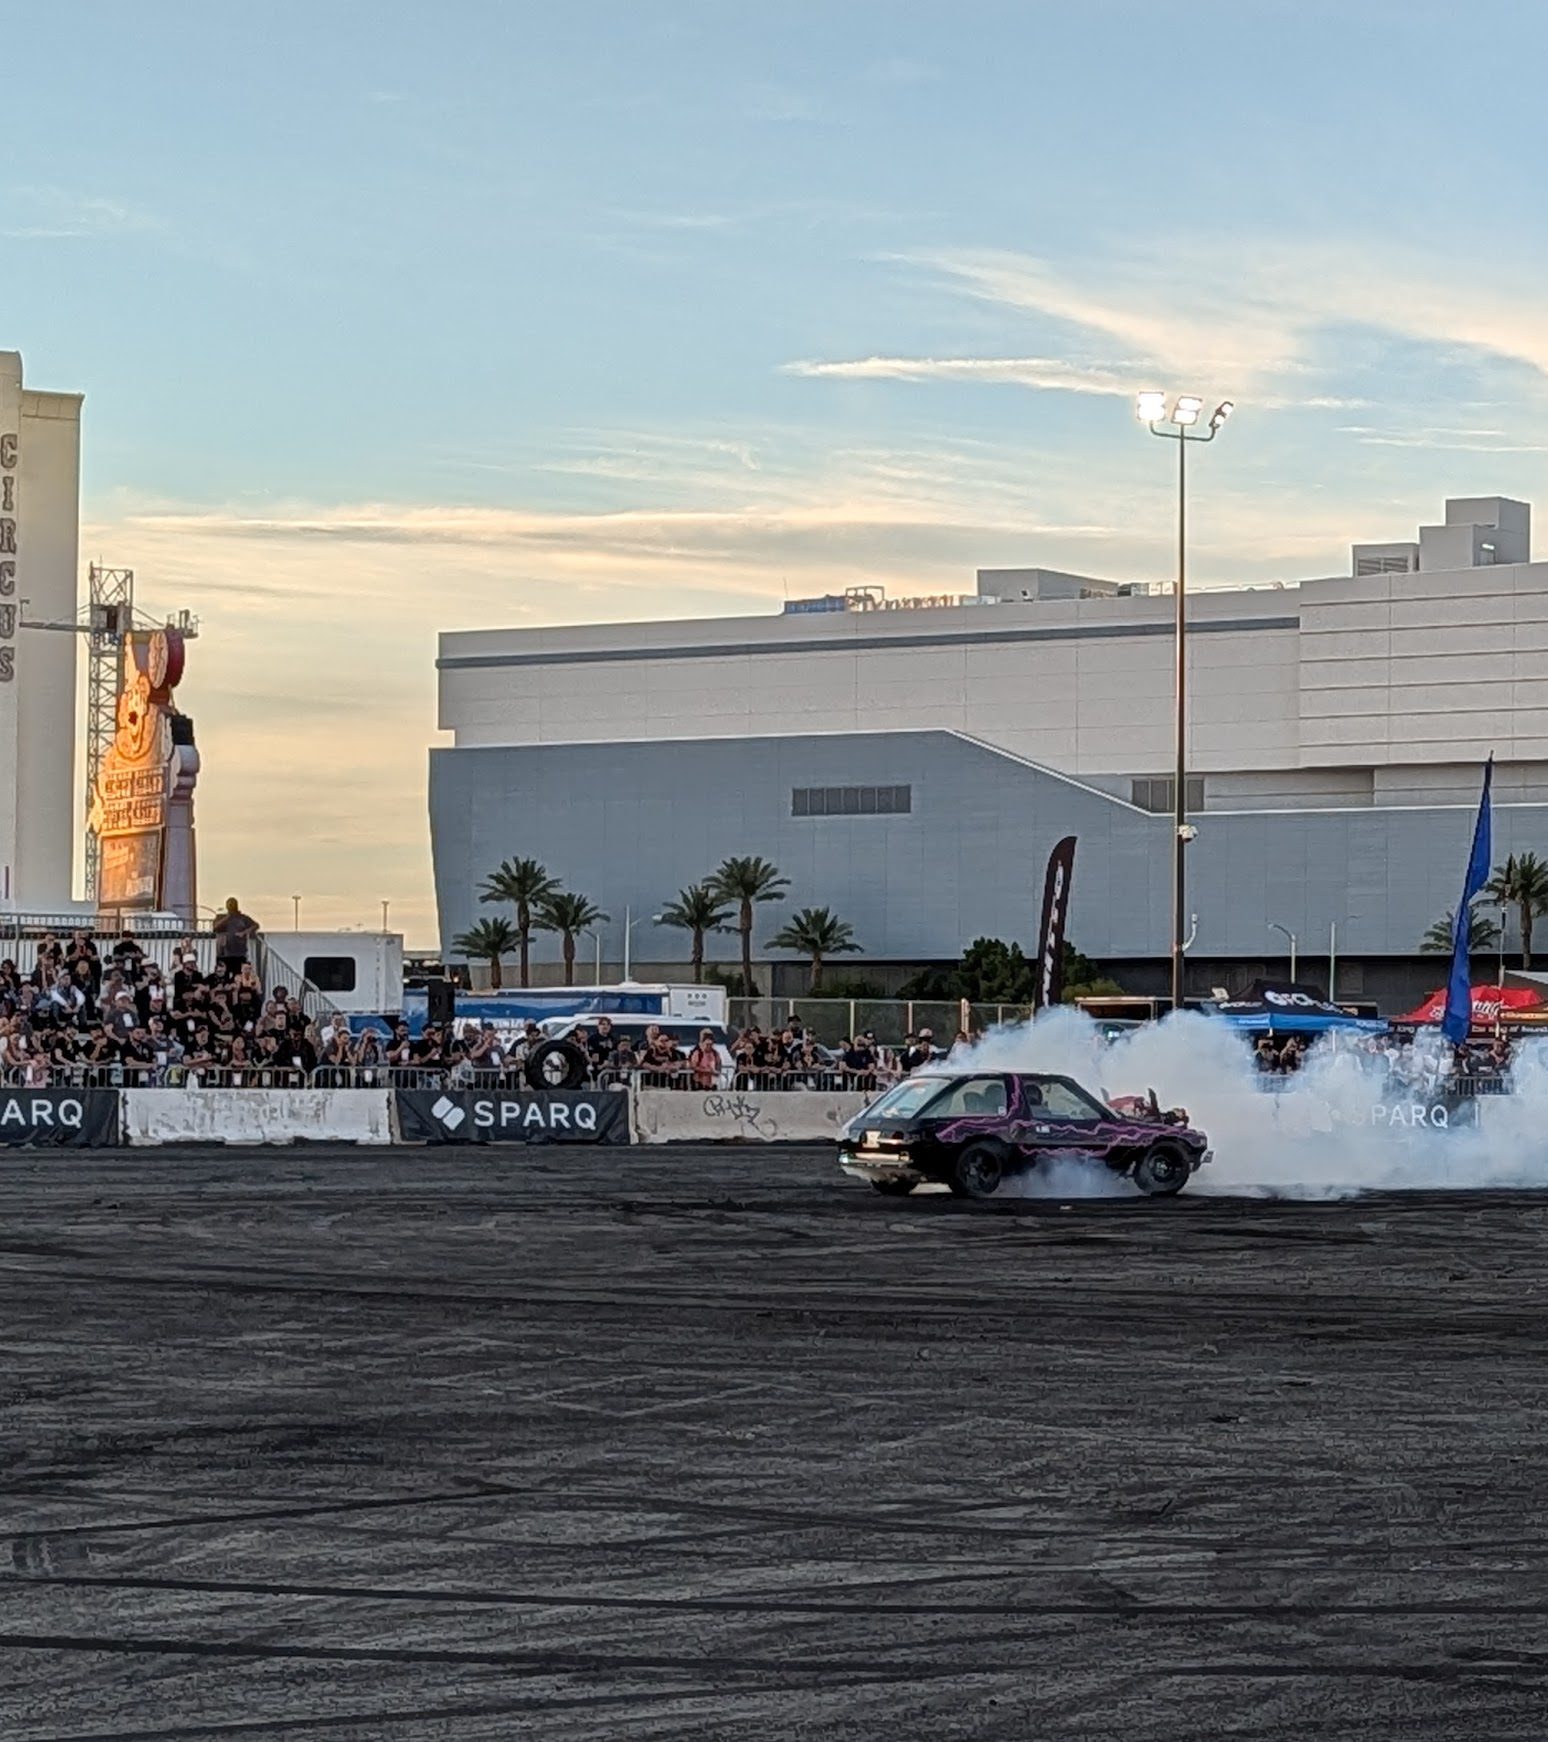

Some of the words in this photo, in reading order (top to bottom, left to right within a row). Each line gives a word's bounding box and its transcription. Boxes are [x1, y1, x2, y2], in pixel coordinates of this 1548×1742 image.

[0, 433, 17, 683] CIRCUS
[0, 1099, 83, 1129] ARQ
[474, 1101, 597, 1130] SPARQ
